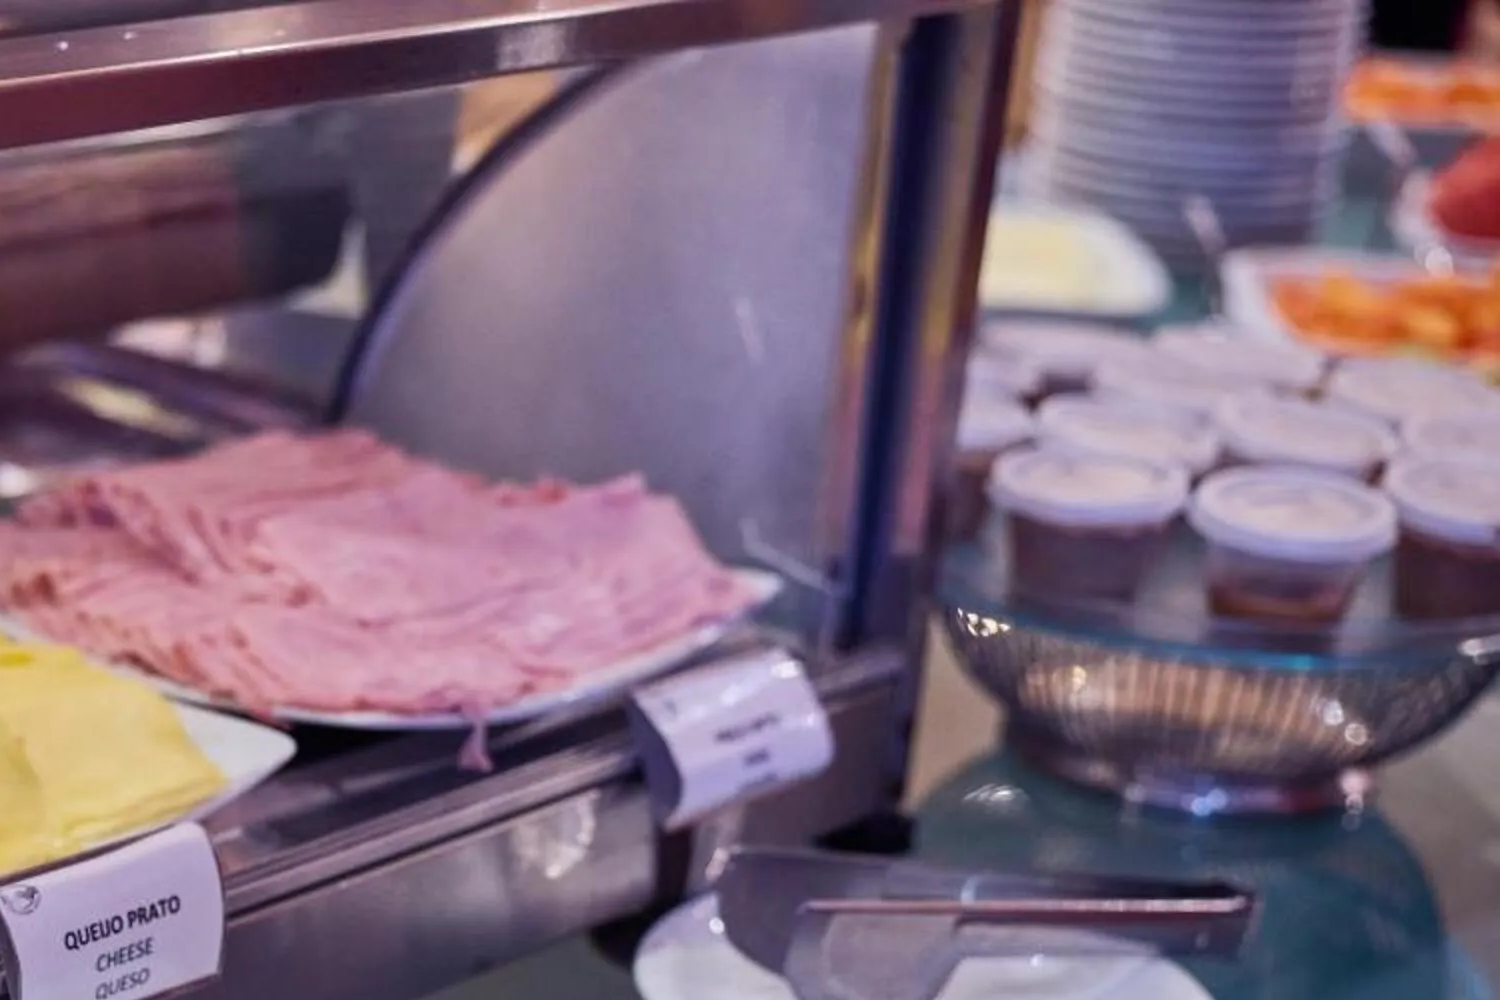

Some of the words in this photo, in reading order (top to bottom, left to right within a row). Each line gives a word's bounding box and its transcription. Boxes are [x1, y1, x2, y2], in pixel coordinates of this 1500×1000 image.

[64, 915, 123, 951] QUEIJO
[127, 895, 181, 928] PRATO
[95, 937, 154, 972] CHEESE
[95, 968, 150, 1000] QUESO
